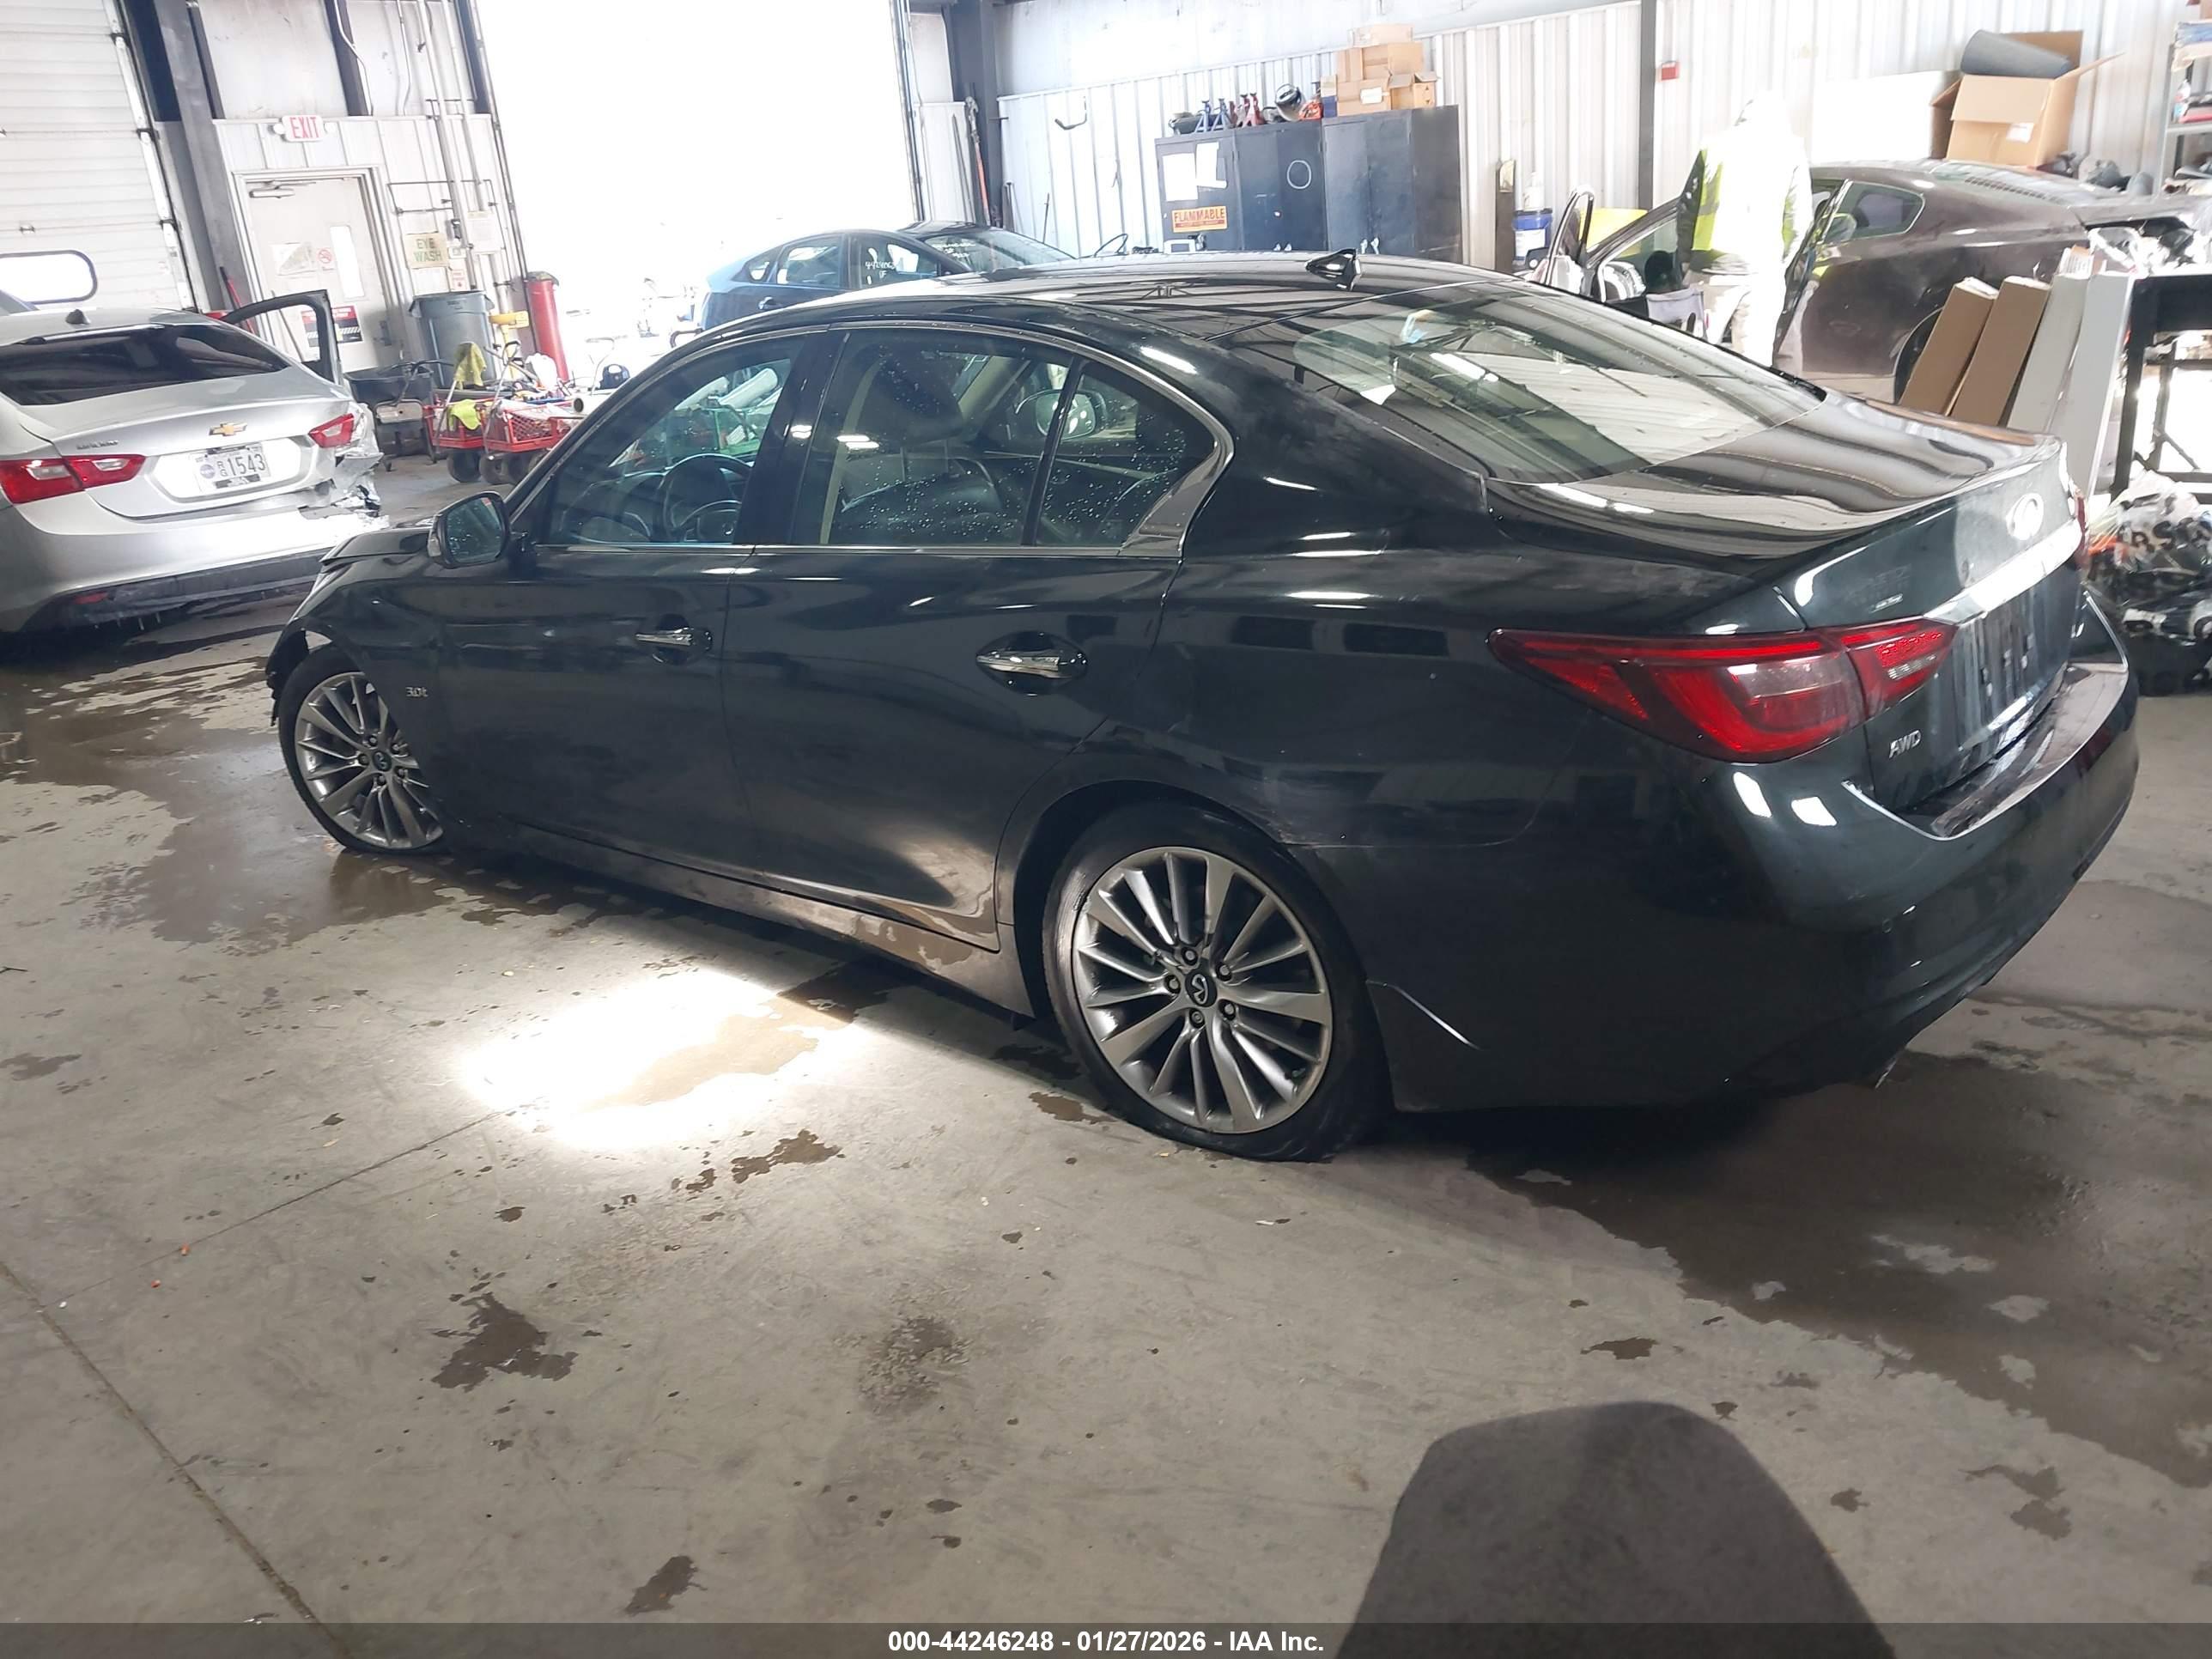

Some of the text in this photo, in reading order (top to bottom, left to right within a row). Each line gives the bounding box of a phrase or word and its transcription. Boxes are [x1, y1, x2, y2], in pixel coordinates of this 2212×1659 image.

[289, 117, 319, 138] EXIT
[1174, 208, 1225, 222] FLAMMABLE
[416, 238, 436, 249] EYE
[414, 252, 442, 262] WASH
[228, 453, 265, 476] 1543
[1889, 730, 1922, 758] AWD
